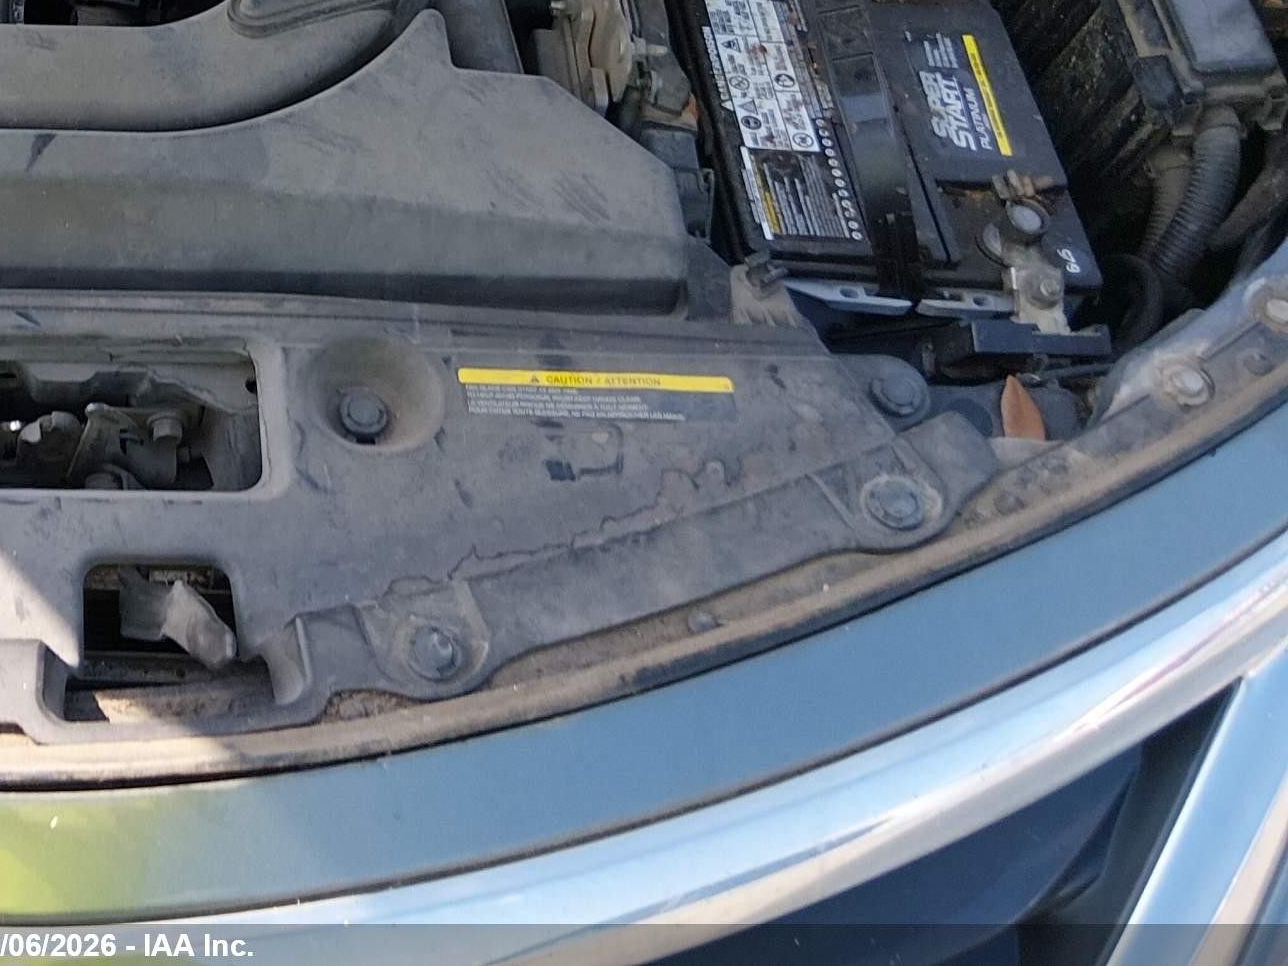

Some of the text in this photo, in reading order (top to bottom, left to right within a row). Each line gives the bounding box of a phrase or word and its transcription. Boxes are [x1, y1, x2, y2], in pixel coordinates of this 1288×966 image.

[919, 70, 948, 138] SUPER
[935, 72, 977, 151] START
[963, 87, 993, 150] PLATINUM
[545, 375, 593, 385] CAUTION
[604, 376, 661, 386] ATTENTION
